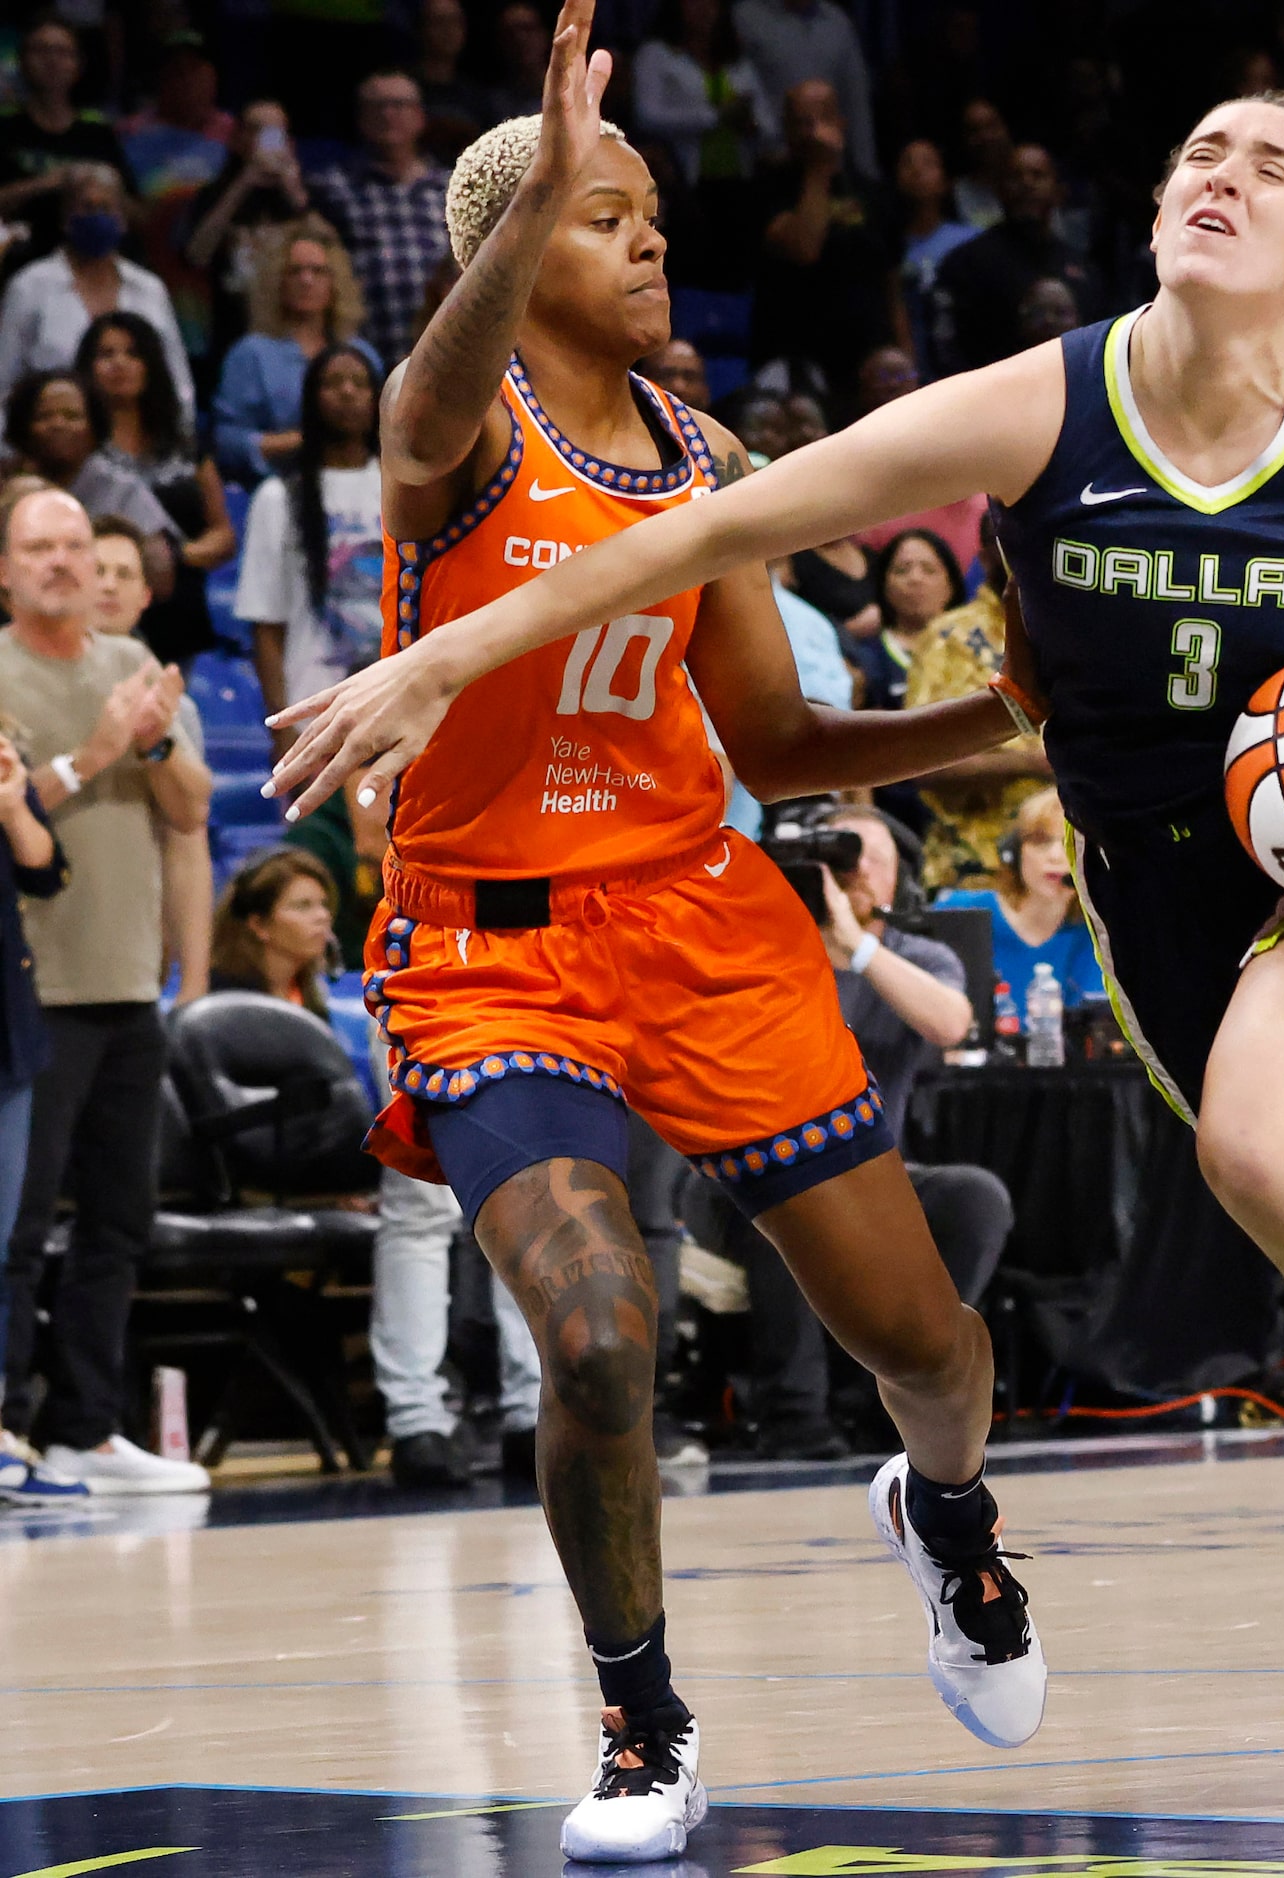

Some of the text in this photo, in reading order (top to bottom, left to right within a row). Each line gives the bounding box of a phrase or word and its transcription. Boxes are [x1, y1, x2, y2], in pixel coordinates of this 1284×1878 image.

[556, 614, 674, 720] 10
[1167, 617, 1222, 711] 3
[551, 736, 591, 761] Yale
[541, 789, 617, 814] Health
